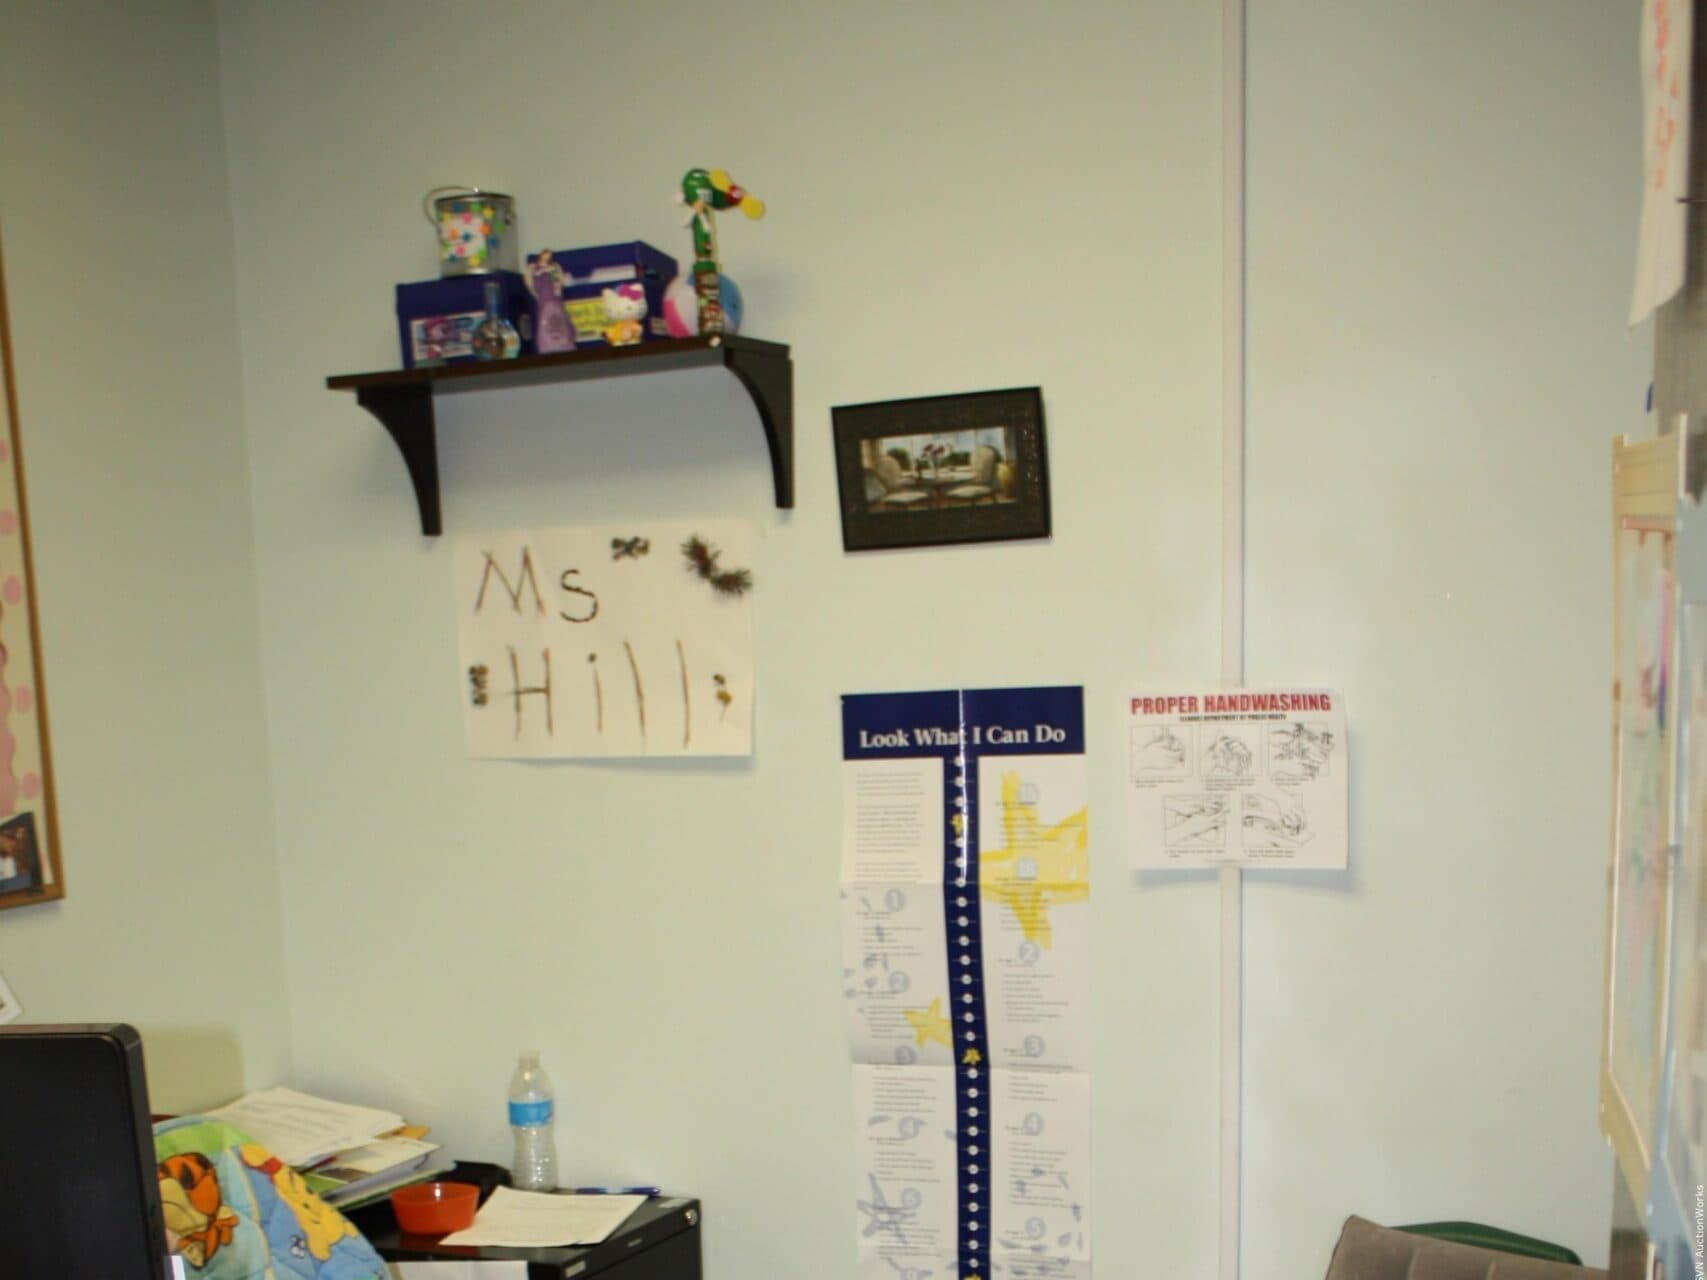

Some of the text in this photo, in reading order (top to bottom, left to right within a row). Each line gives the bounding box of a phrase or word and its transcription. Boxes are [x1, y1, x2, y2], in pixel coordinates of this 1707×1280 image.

[476, 545, 599, 623] Ms
[1130, 693, 1332, 715] PROPER HANDWASHING
[859, 724, 1067, 748] Look What I Can Do
